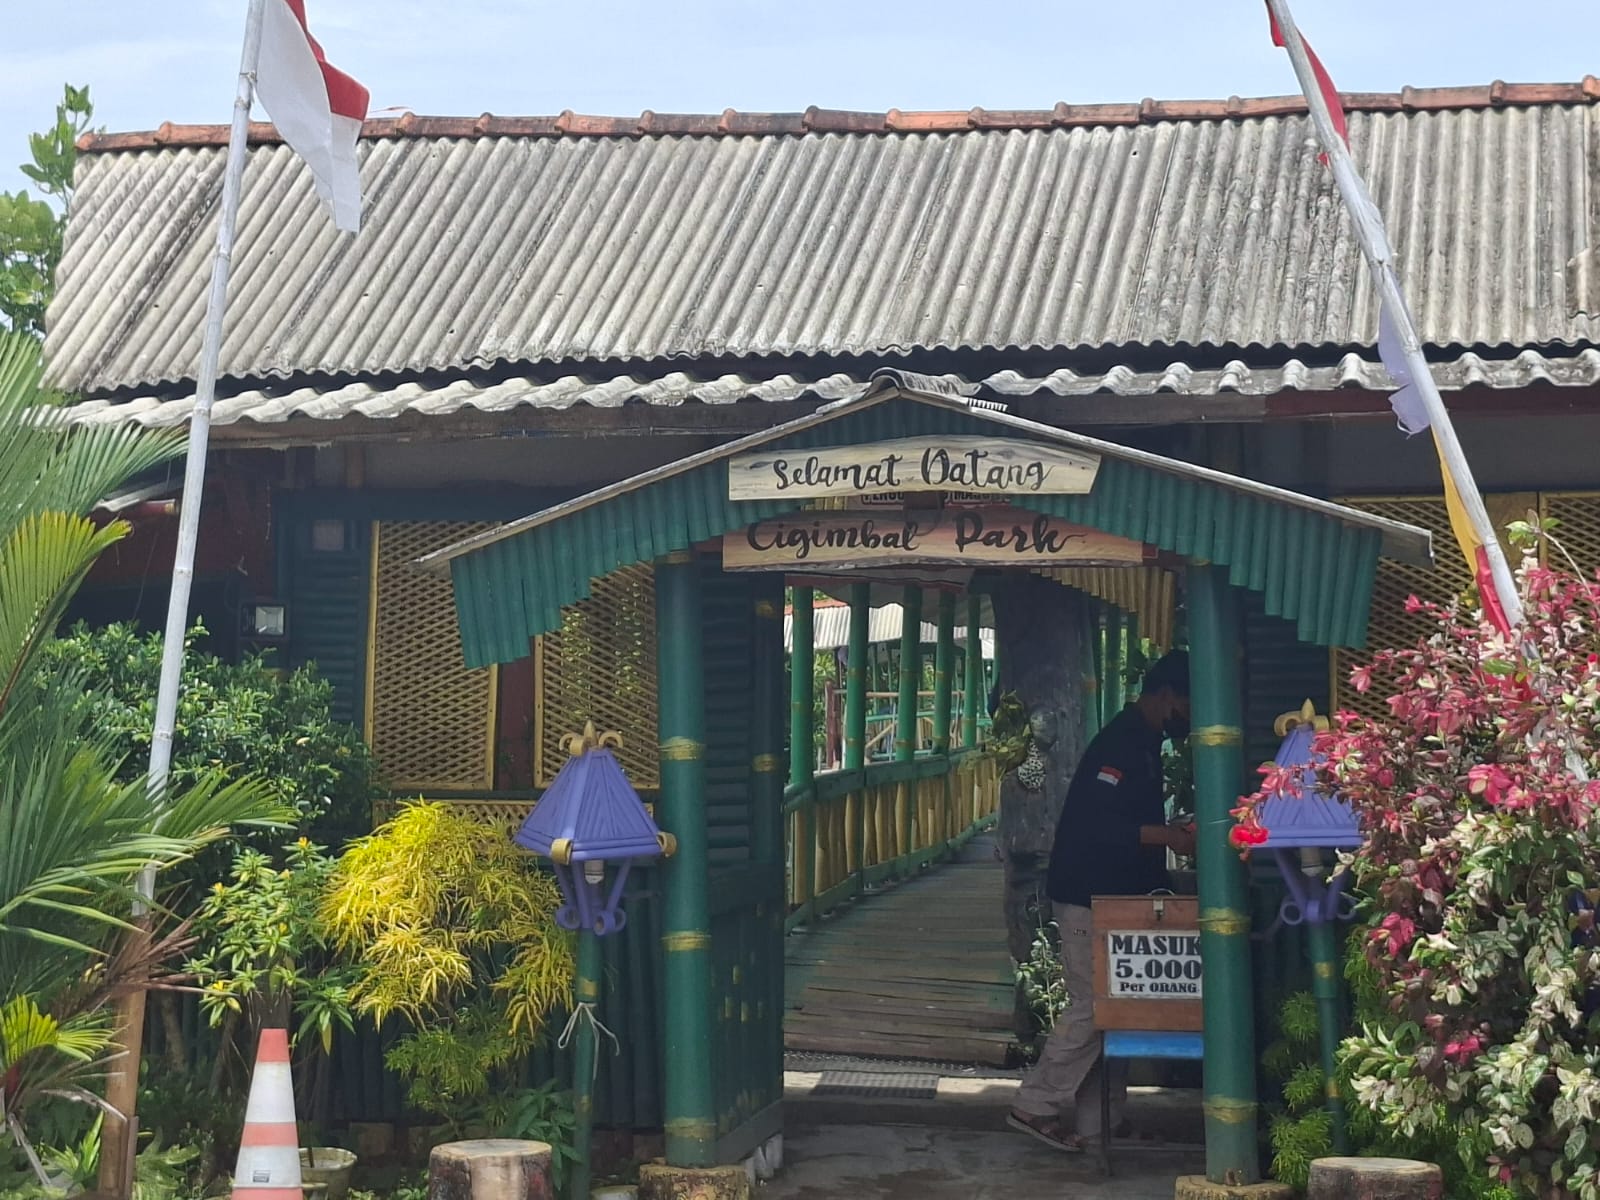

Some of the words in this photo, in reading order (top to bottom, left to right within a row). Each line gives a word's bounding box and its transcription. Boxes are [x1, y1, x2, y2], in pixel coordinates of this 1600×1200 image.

[773, 455, 903, 490] Selamat
[921, 447, 1056, 491] Datang
[747, 519, 919, 559] Cigimbal
[952, 511, 1087, 554] Park
[1111, 935, 1200, 956] MASUK
[1115, 958, 1202, 979] 5.000
[1120, 982, 1145, 992] Per
[1149, 983, 1197, 993] ORANG
